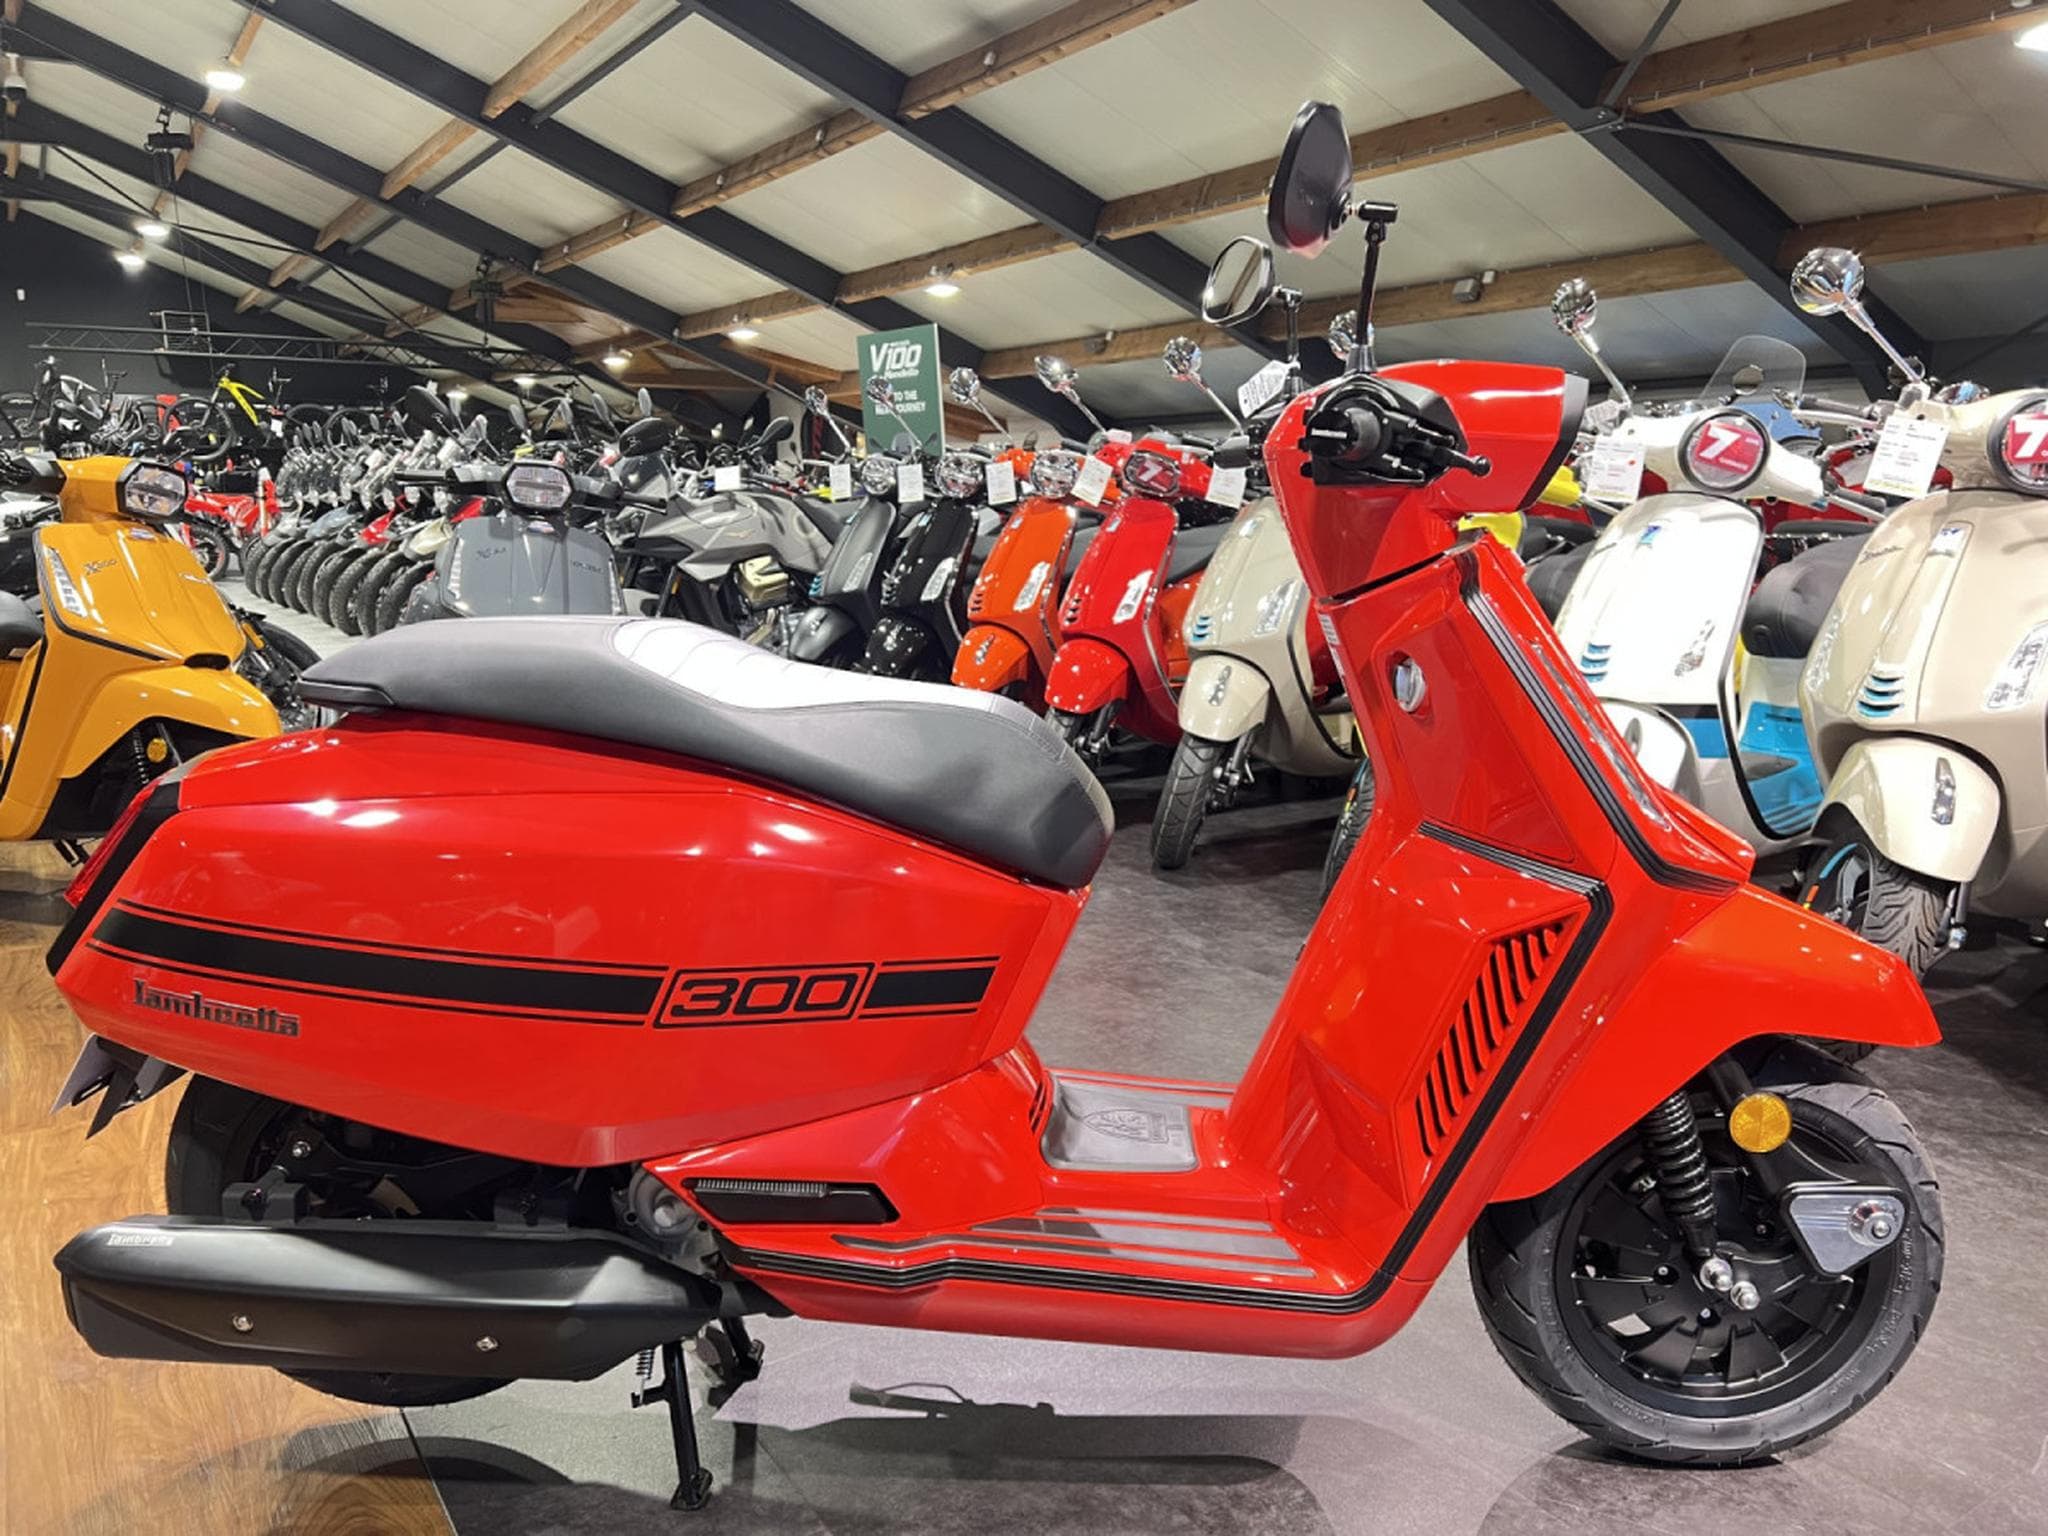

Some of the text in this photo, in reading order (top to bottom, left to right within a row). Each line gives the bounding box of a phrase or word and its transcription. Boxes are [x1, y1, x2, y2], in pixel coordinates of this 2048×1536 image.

[870, 342, 922, 372] V100
[1699, 426, 1741, 460] 7
[2014, 419, 2048, 458] 7
[1139, 460, 1163, 481] 7
[671, 973, 859, 1017] 300
